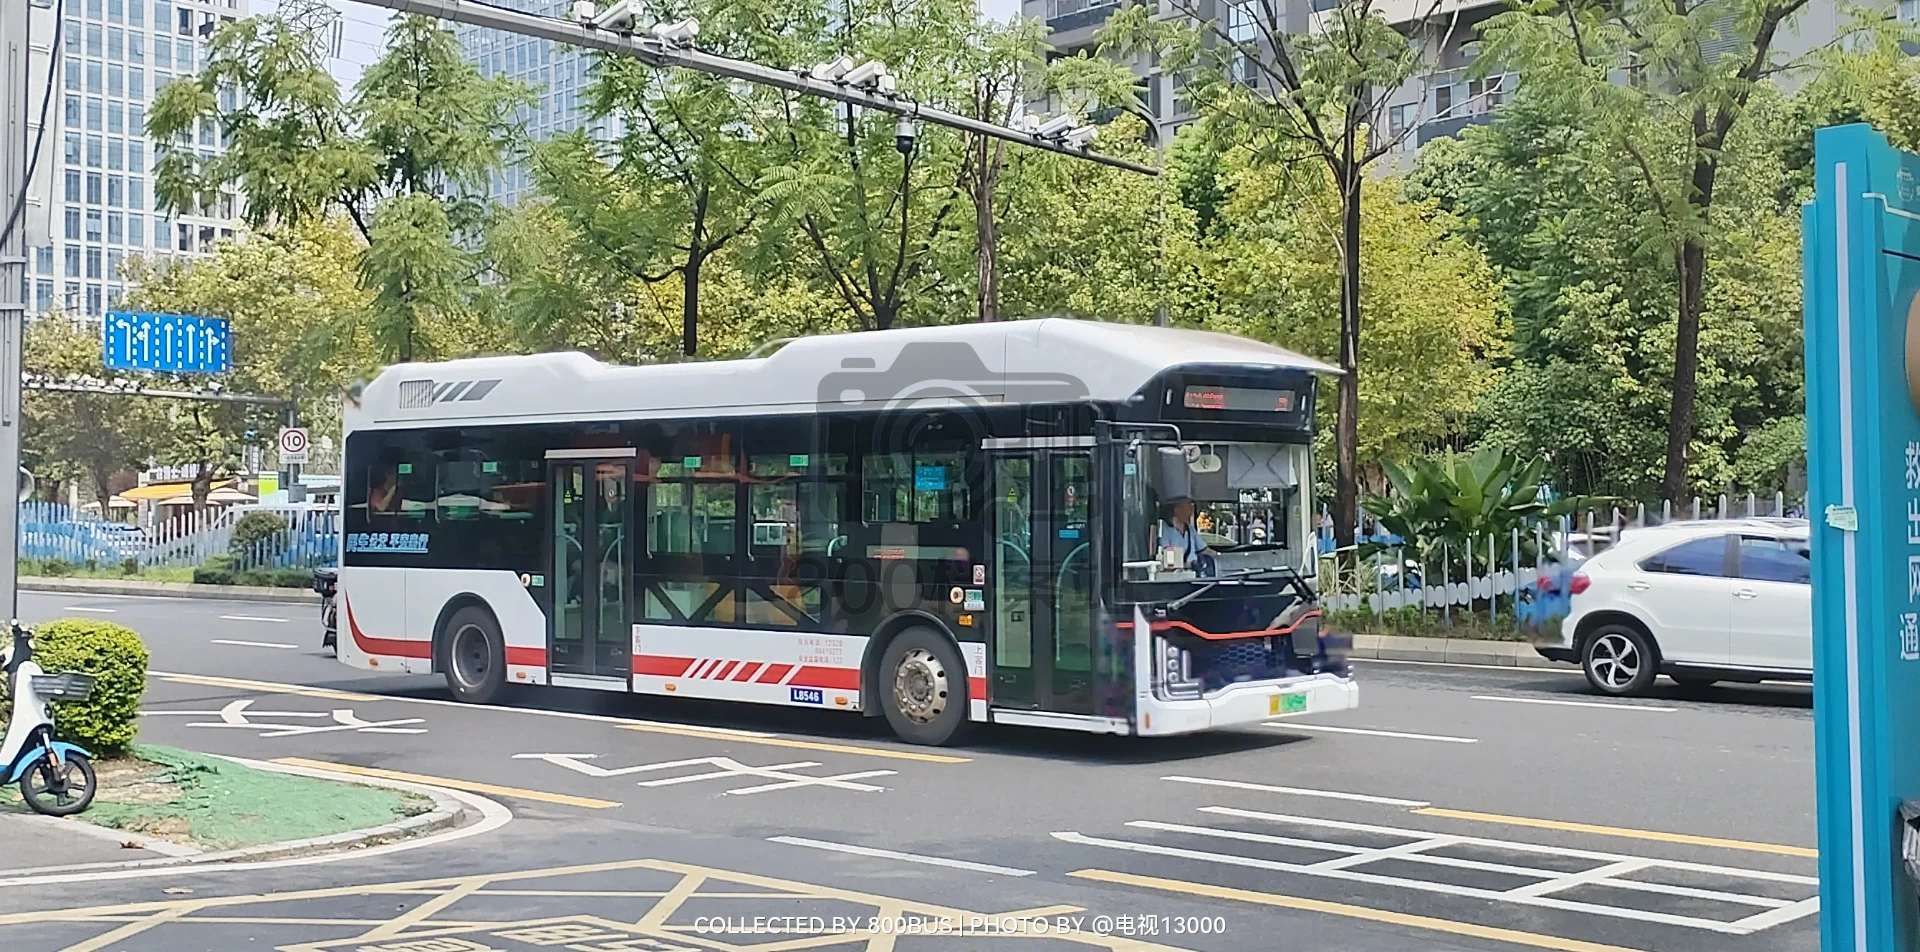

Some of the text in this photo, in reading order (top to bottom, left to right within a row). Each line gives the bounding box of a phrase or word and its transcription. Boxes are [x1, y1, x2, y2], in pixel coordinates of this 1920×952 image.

[286, 435, 302, 447] 10
[974, 645, 983, 675] 上客门
[793, 690, 820, 702] L8546
